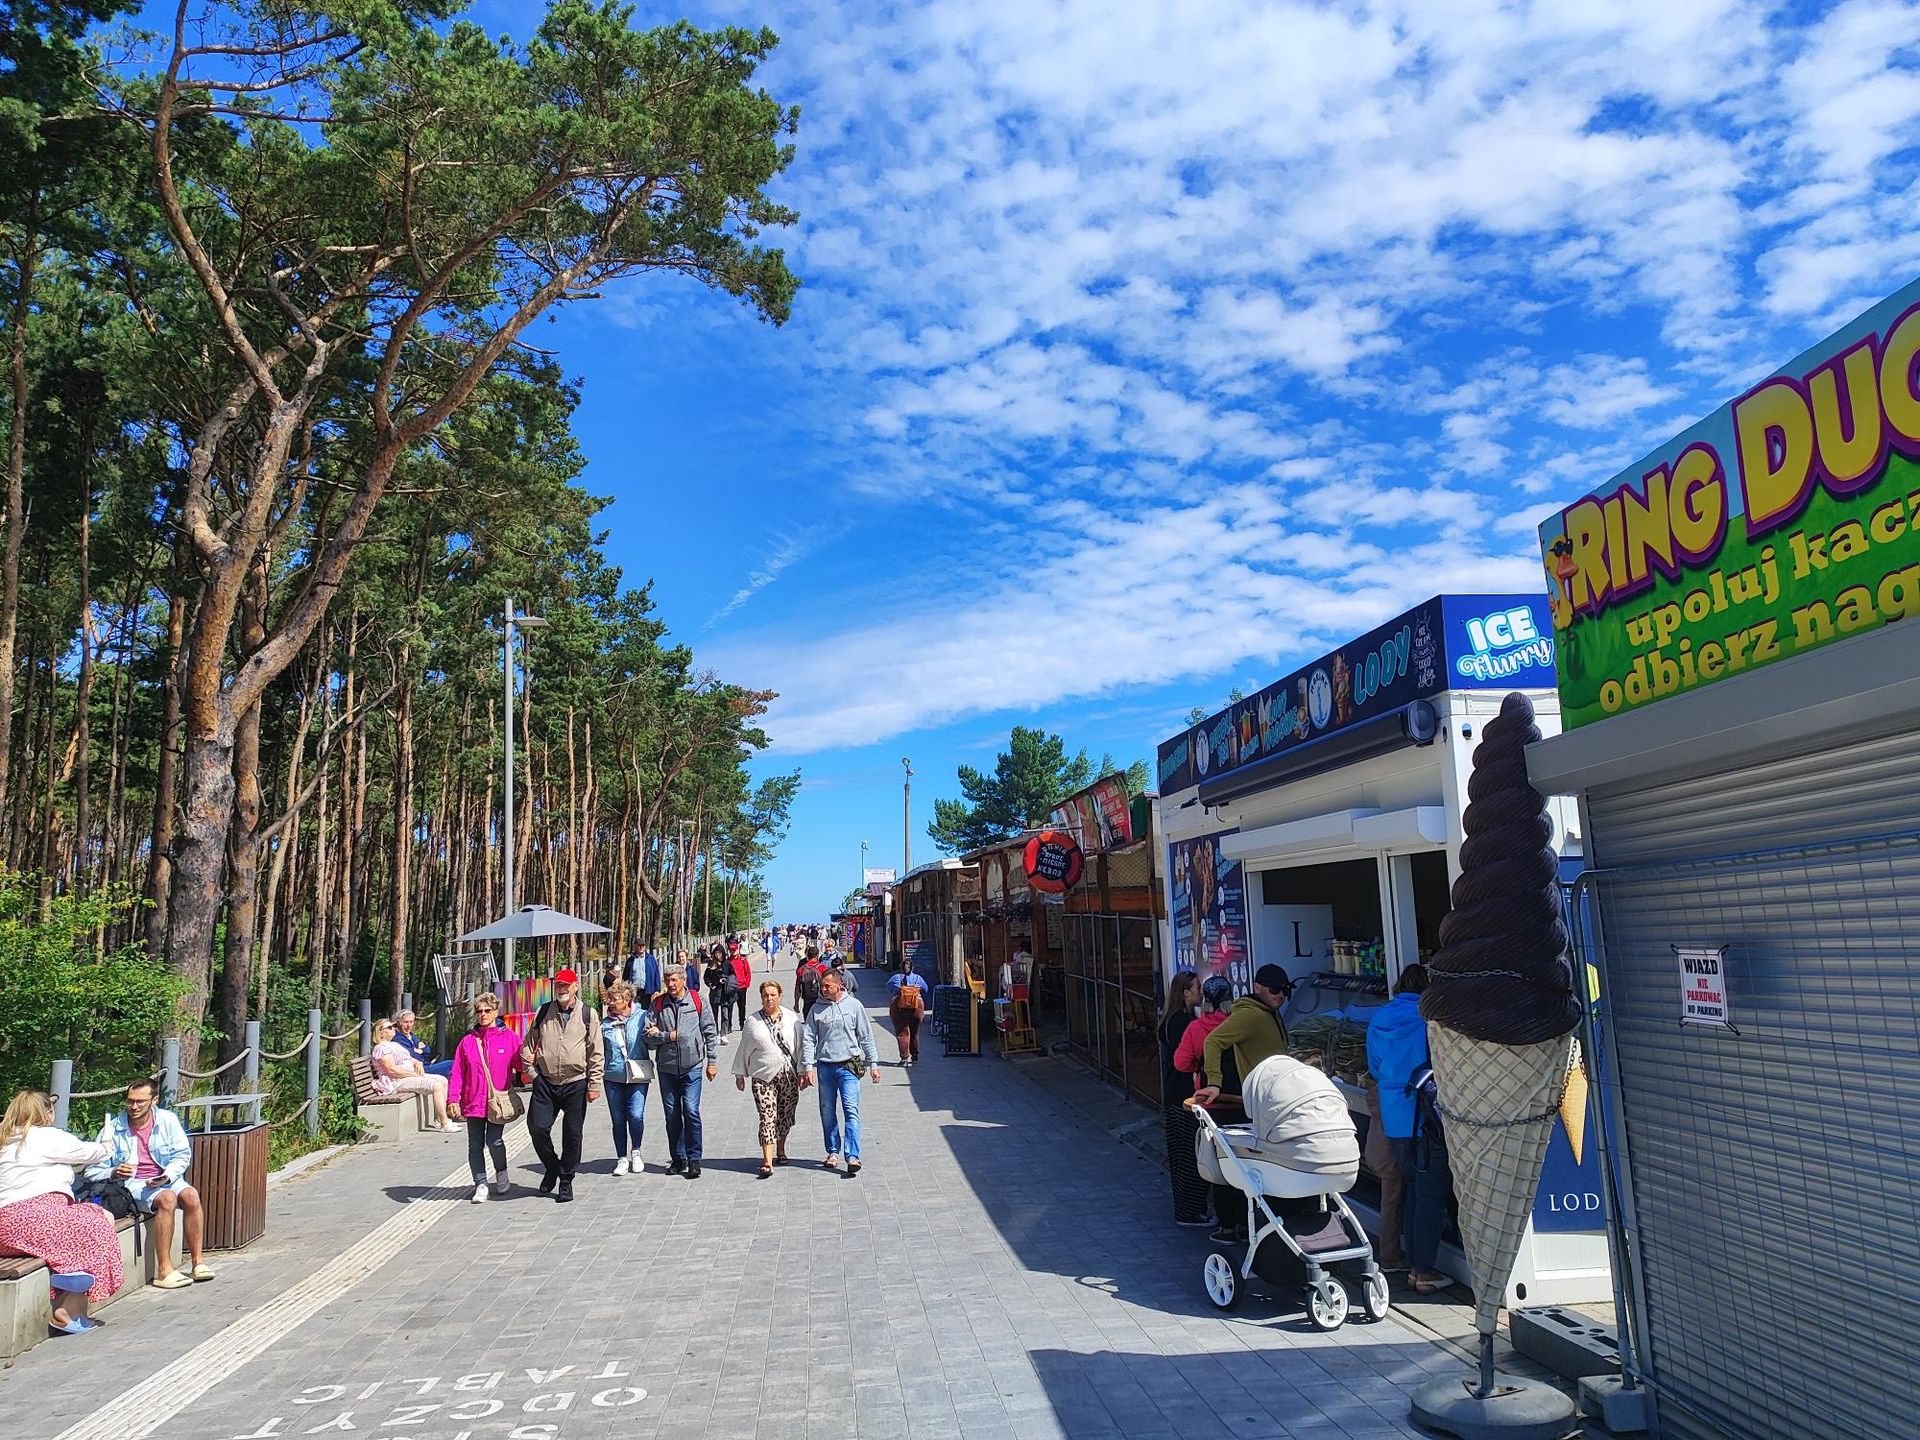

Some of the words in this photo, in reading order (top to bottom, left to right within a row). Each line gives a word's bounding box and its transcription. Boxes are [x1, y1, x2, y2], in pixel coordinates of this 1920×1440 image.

[1565, 445, 1727, 611] RING
[1626, 546, 1780, 647] upoluj
[1467, 606, 1538, 653] ICE
[1354, 624, 1410, 706] LODY
[1600, 618, 1780, 713] odbierz
[1684, 958, 1718, 975] WJAZD
[1697, 978, 1709, 989] NIE
[1688, 1004, 1696, 1014] NO
[1697, 1005, 1723, 1017] PARKING
